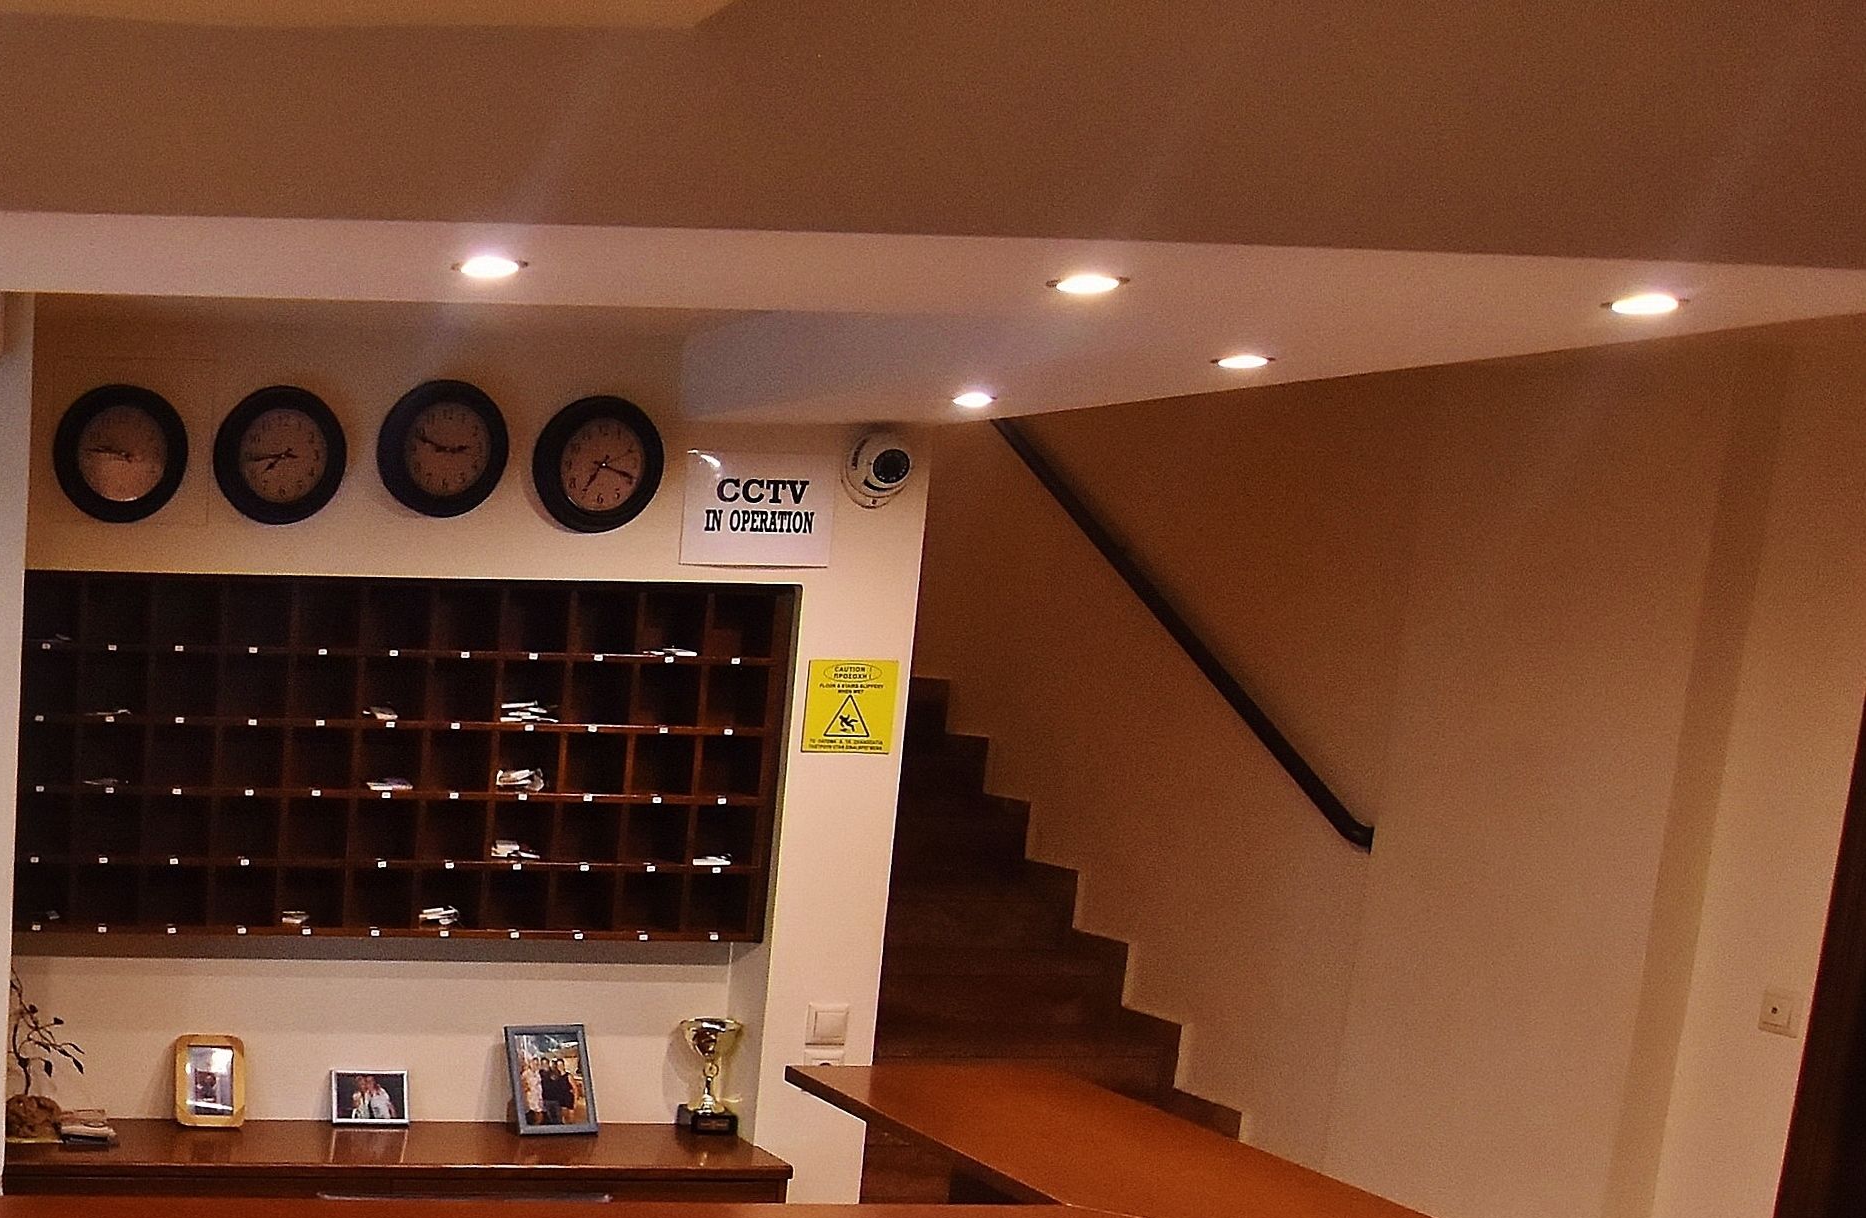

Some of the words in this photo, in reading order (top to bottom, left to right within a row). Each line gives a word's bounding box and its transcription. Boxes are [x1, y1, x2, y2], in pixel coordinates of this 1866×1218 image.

[716, 478, 809, 504] CCTV
[704, 509, 723, 531] IN
[730, 510, 815, 534] OPERATION
